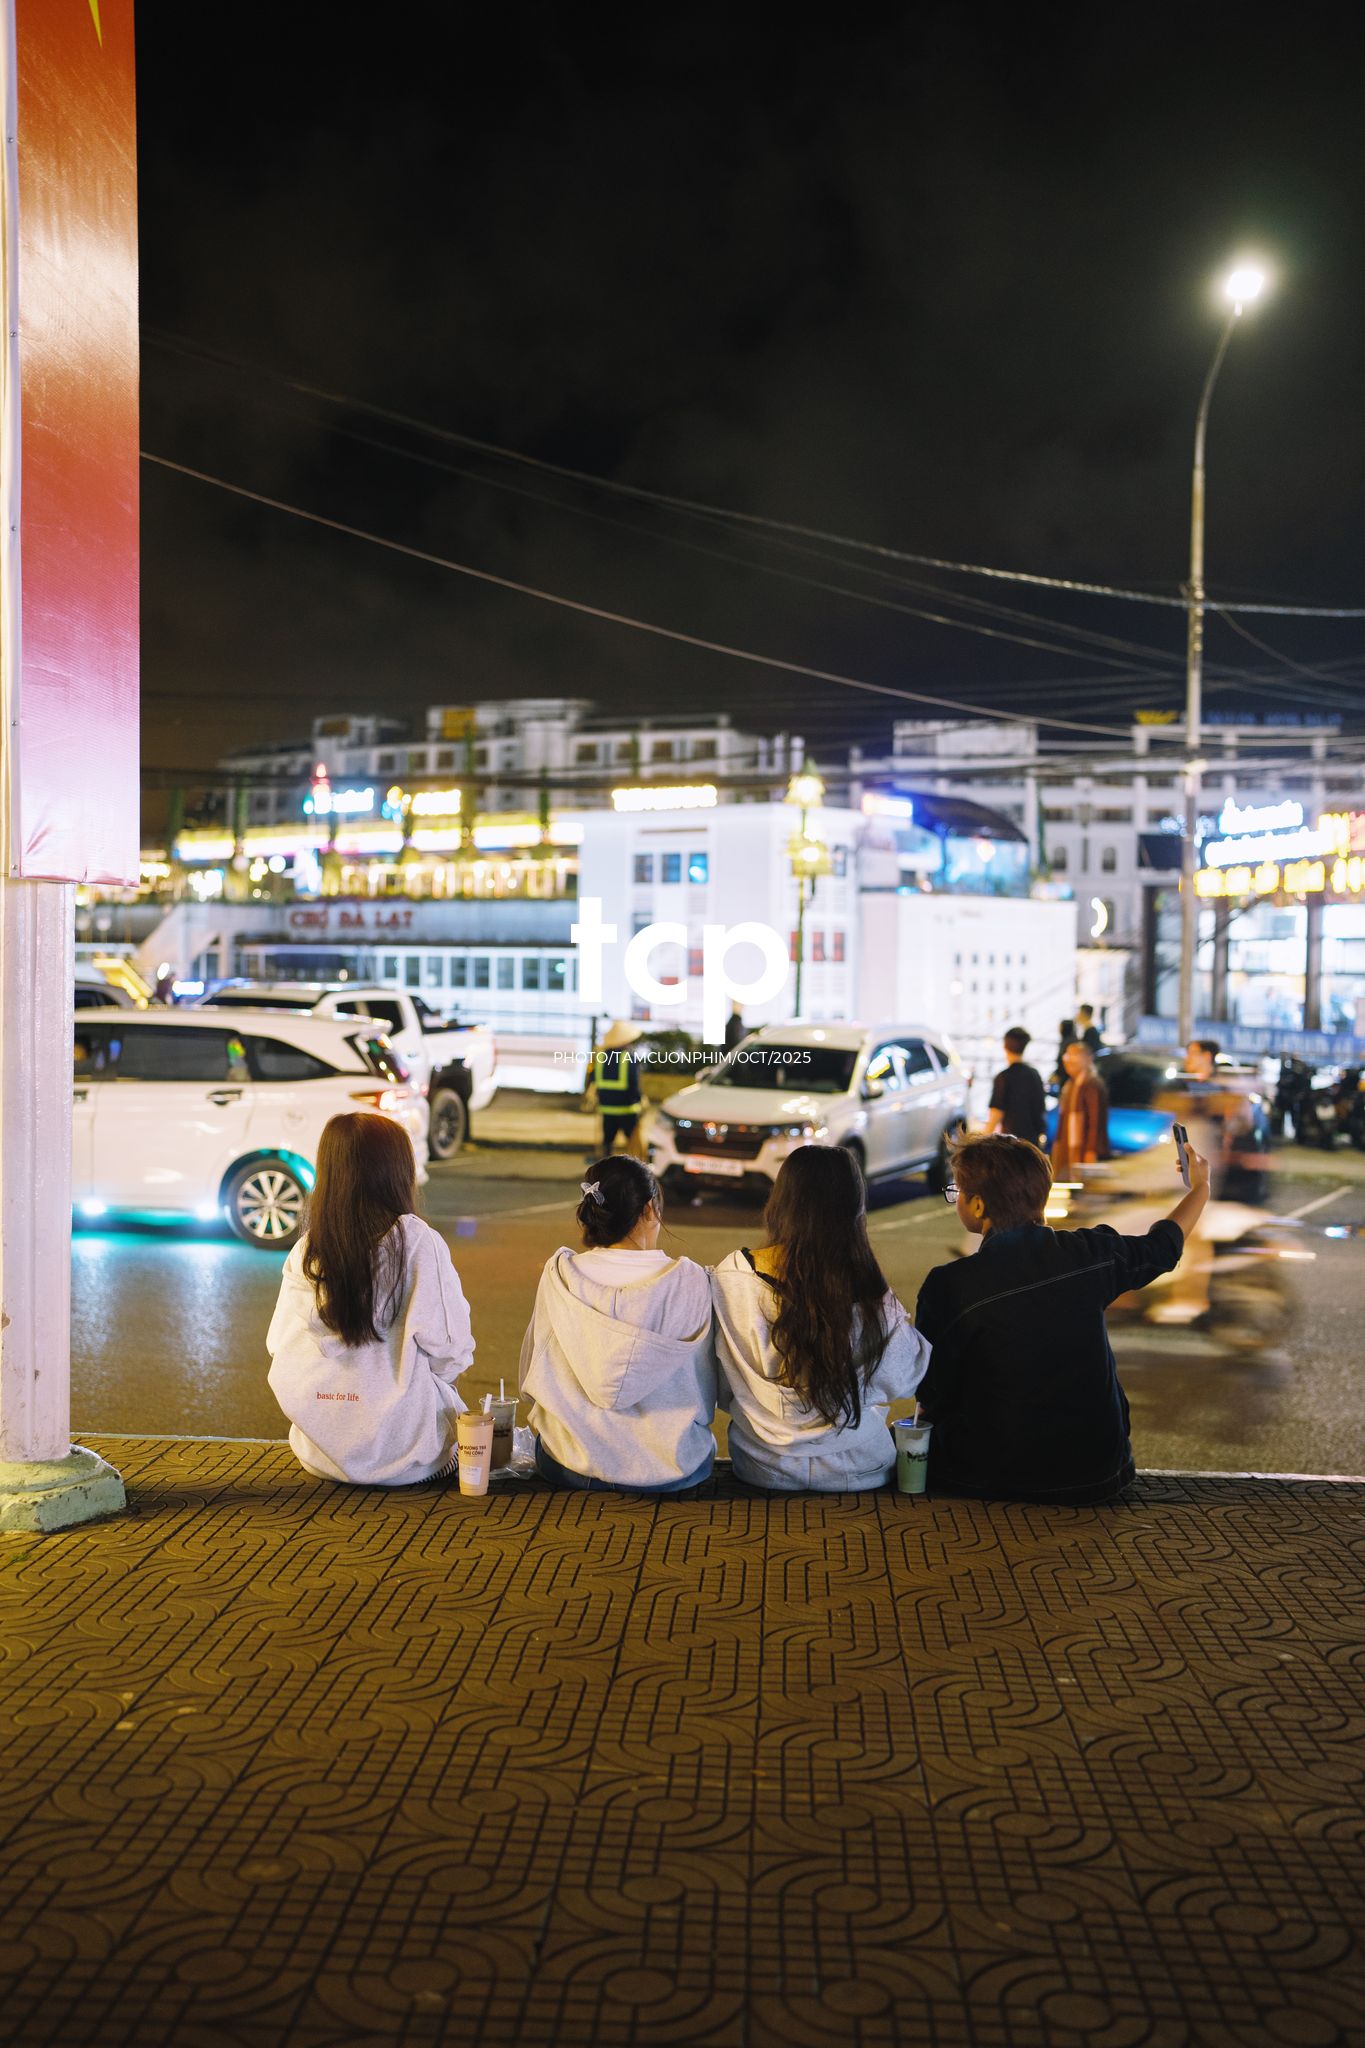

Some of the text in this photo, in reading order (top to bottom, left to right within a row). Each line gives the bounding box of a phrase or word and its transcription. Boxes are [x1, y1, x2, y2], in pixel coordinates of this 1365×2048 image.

[316, 1391, 360, 1402] basic for life
